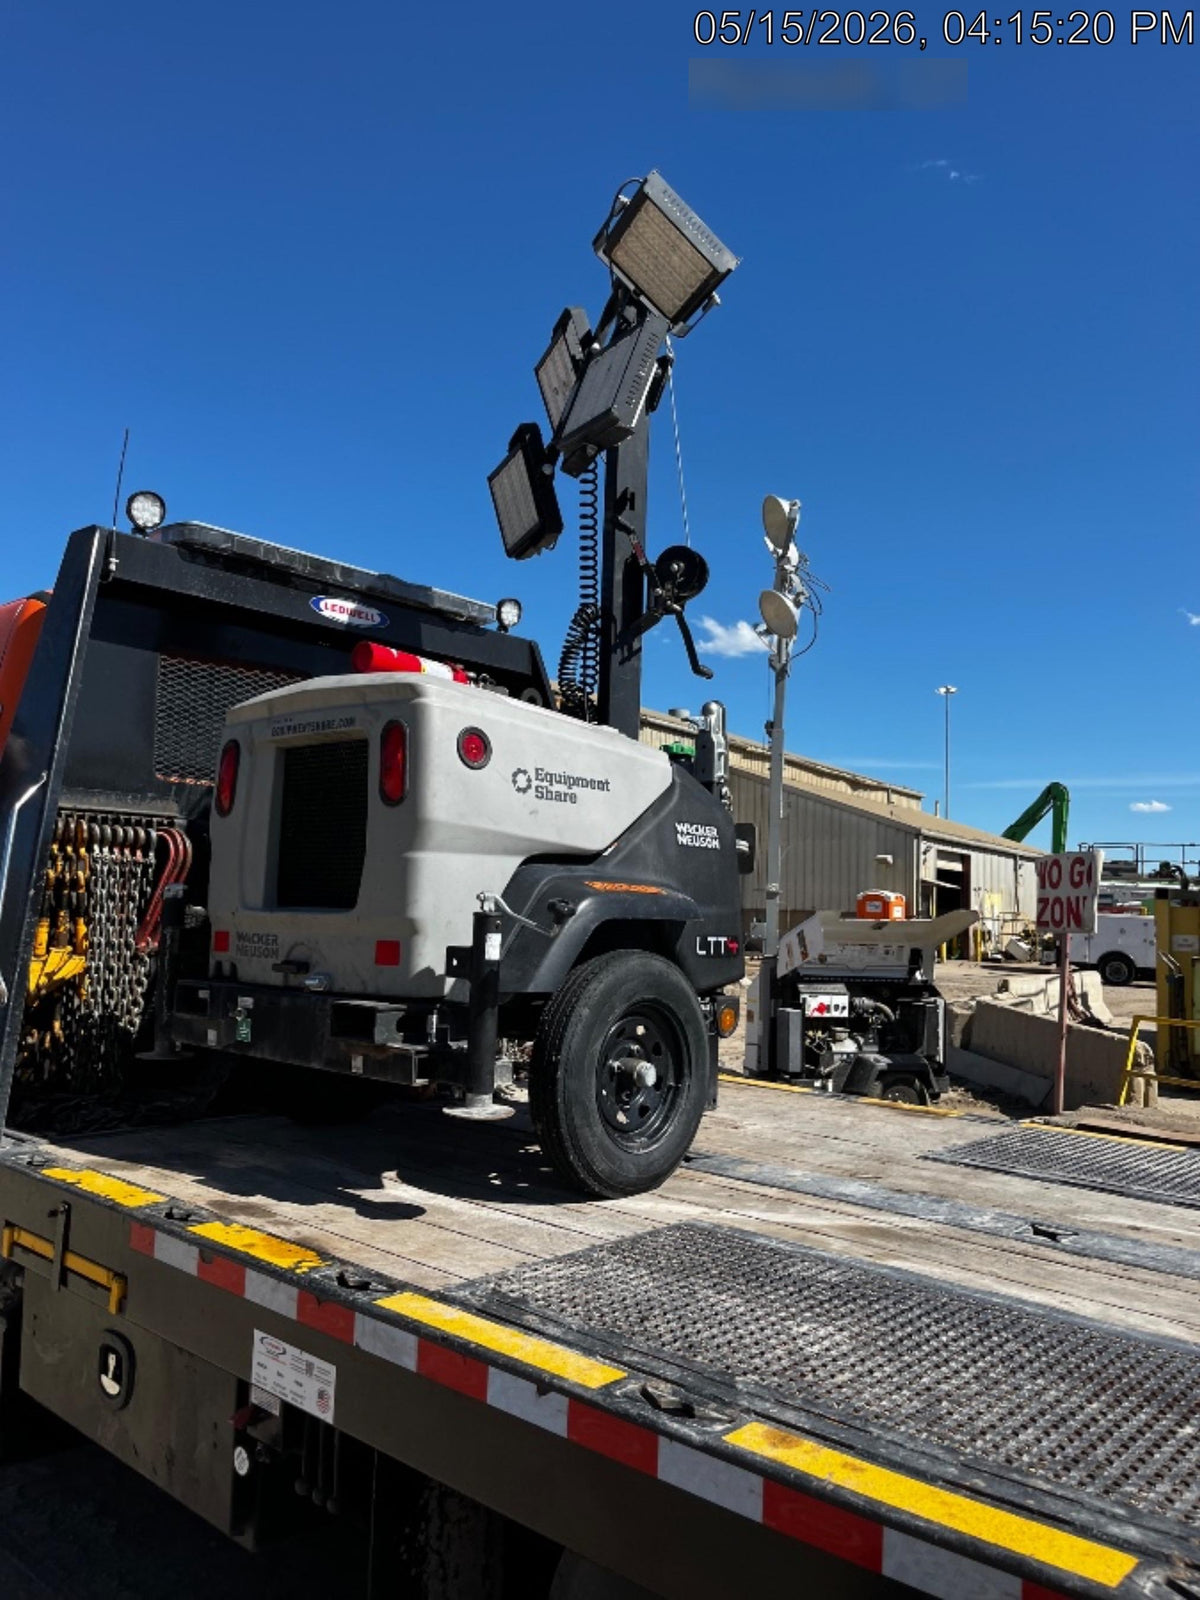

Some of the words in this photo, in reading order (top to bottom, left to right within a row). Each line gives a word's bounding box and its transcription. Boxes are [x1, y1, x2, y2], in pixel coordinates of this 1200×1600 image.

[324, 602, 376, 623] LEDWELL
[534, 767, 611, 792] Equipment
[534, 785, 577, 804] Share
[675, 822, 719, 838] WACKER
[677, 834, 721, 850] NEUSON
[236, 930, 279, 947] WACKER
[236, 944, 280, 960] NEUSON
